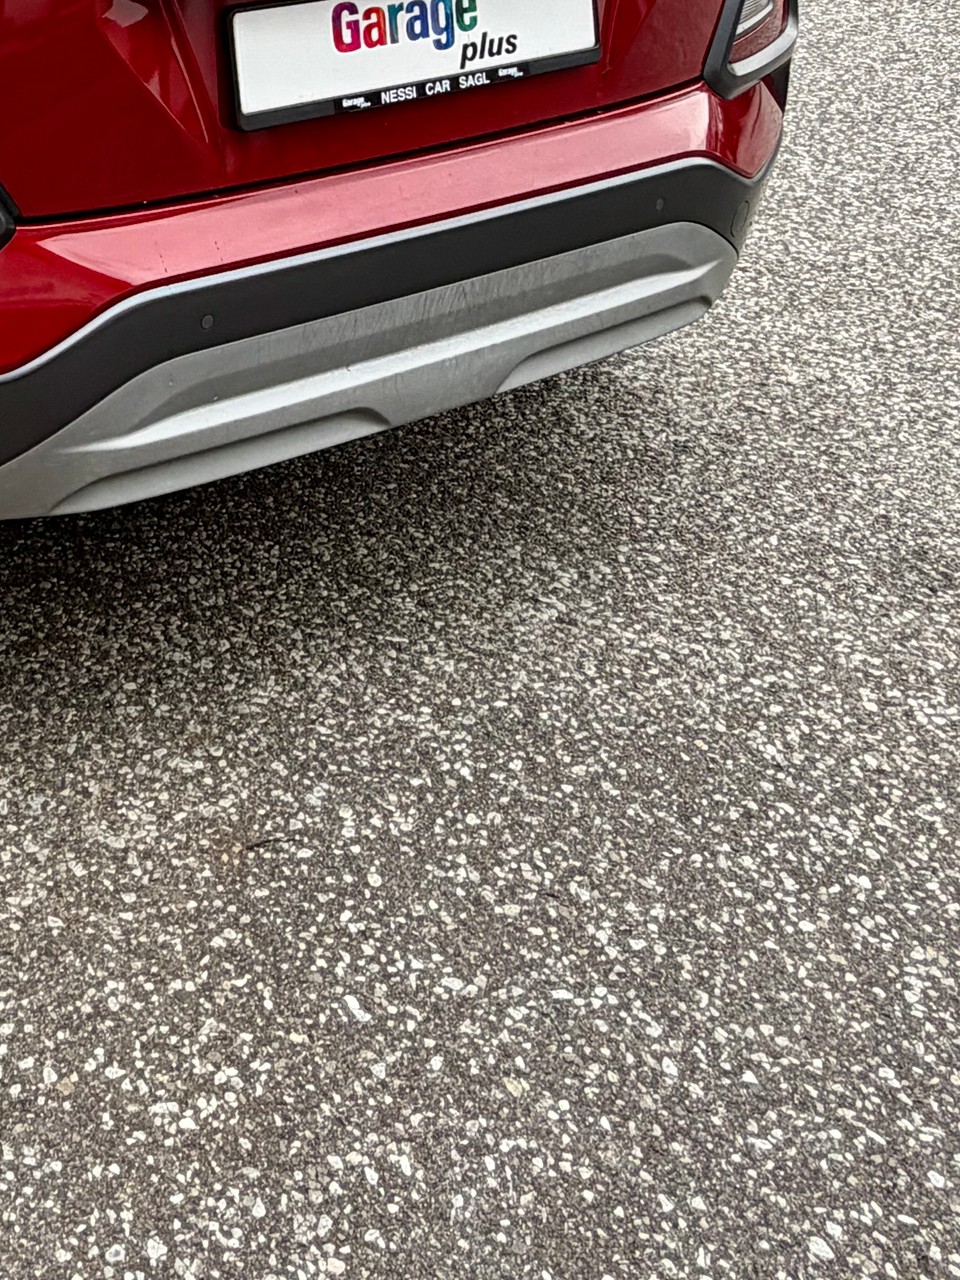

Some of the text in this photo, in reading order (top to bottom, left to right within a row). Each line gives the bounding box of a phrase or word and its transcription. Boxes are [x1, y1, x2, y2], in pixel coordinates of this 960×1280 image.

[460, 31, 518, 69] plus
[380, 72, 490, 104] NESSI CAR SAGL
